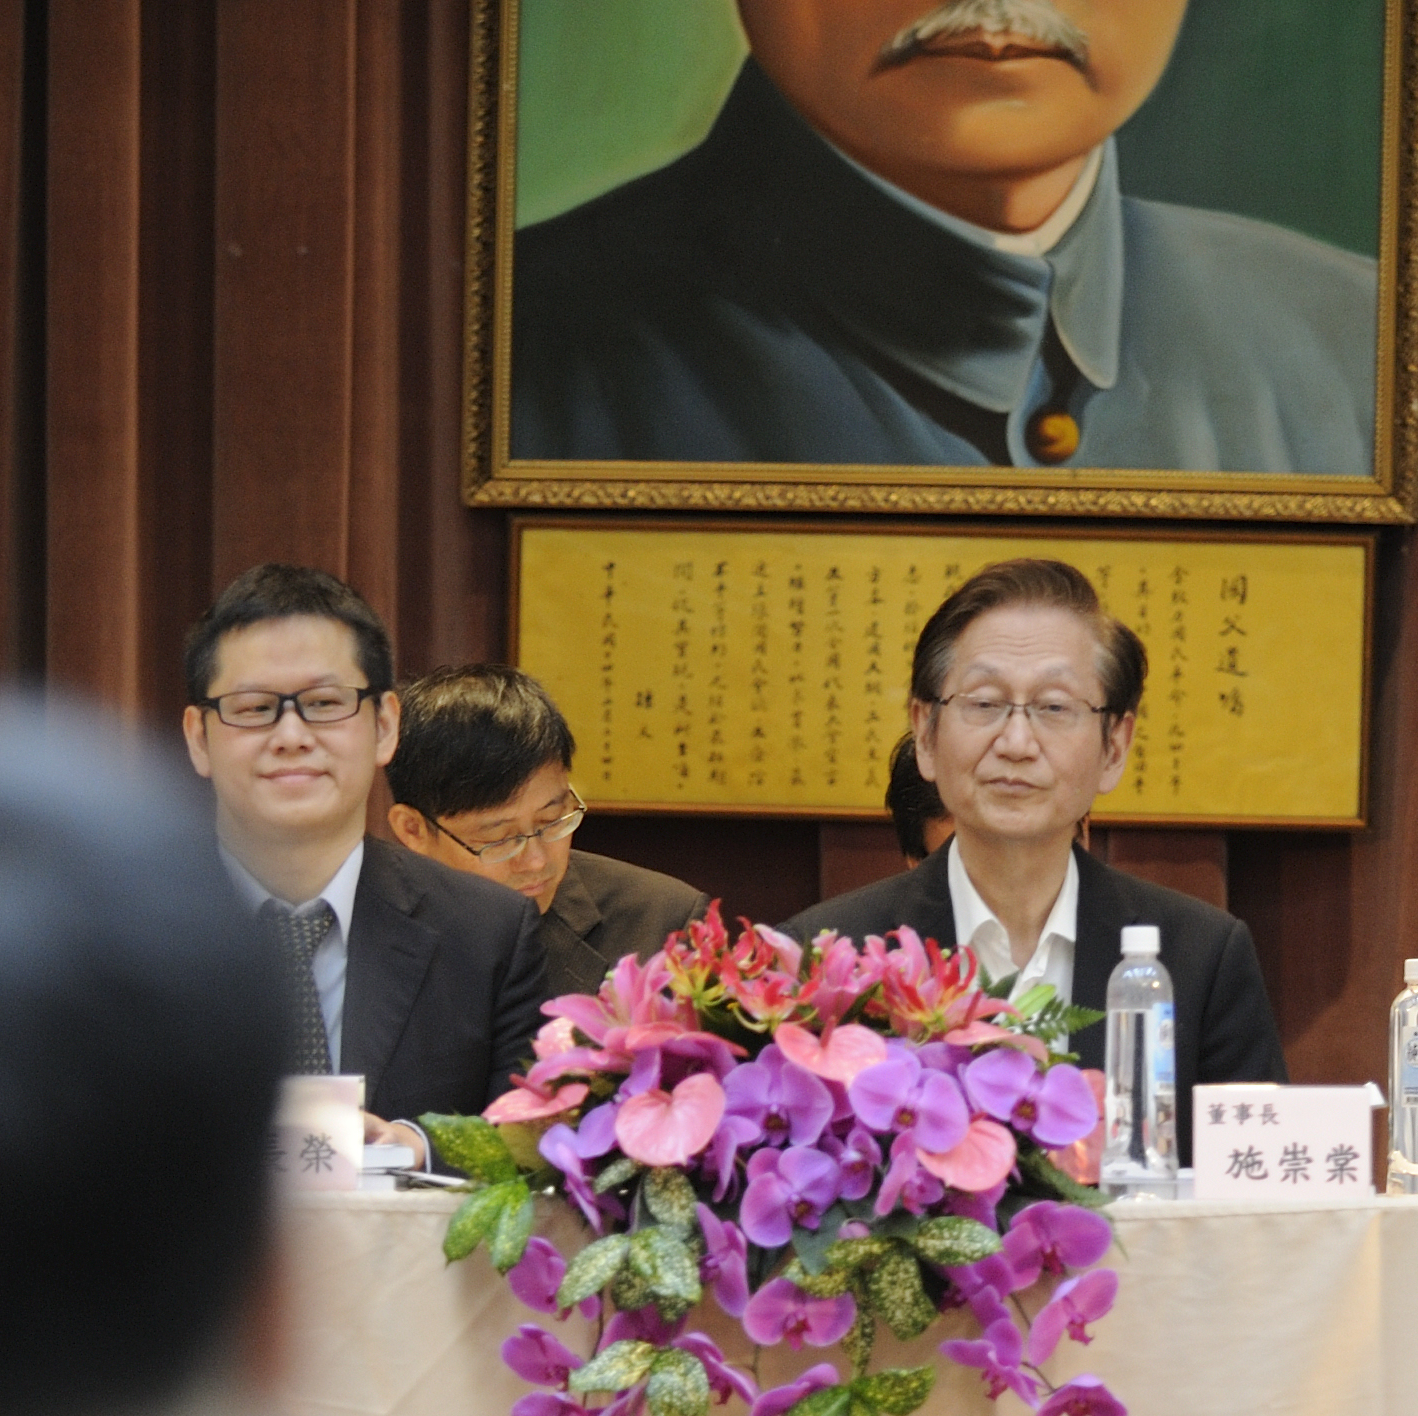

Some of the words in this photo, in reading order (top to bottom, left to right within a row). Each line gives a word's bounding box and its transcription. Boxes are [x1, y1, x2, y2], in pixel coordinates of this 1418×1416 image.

[1207, 1103, 1280, 1125] 董事長
[1225, 1142, 1360, 1185] 施崇棠
